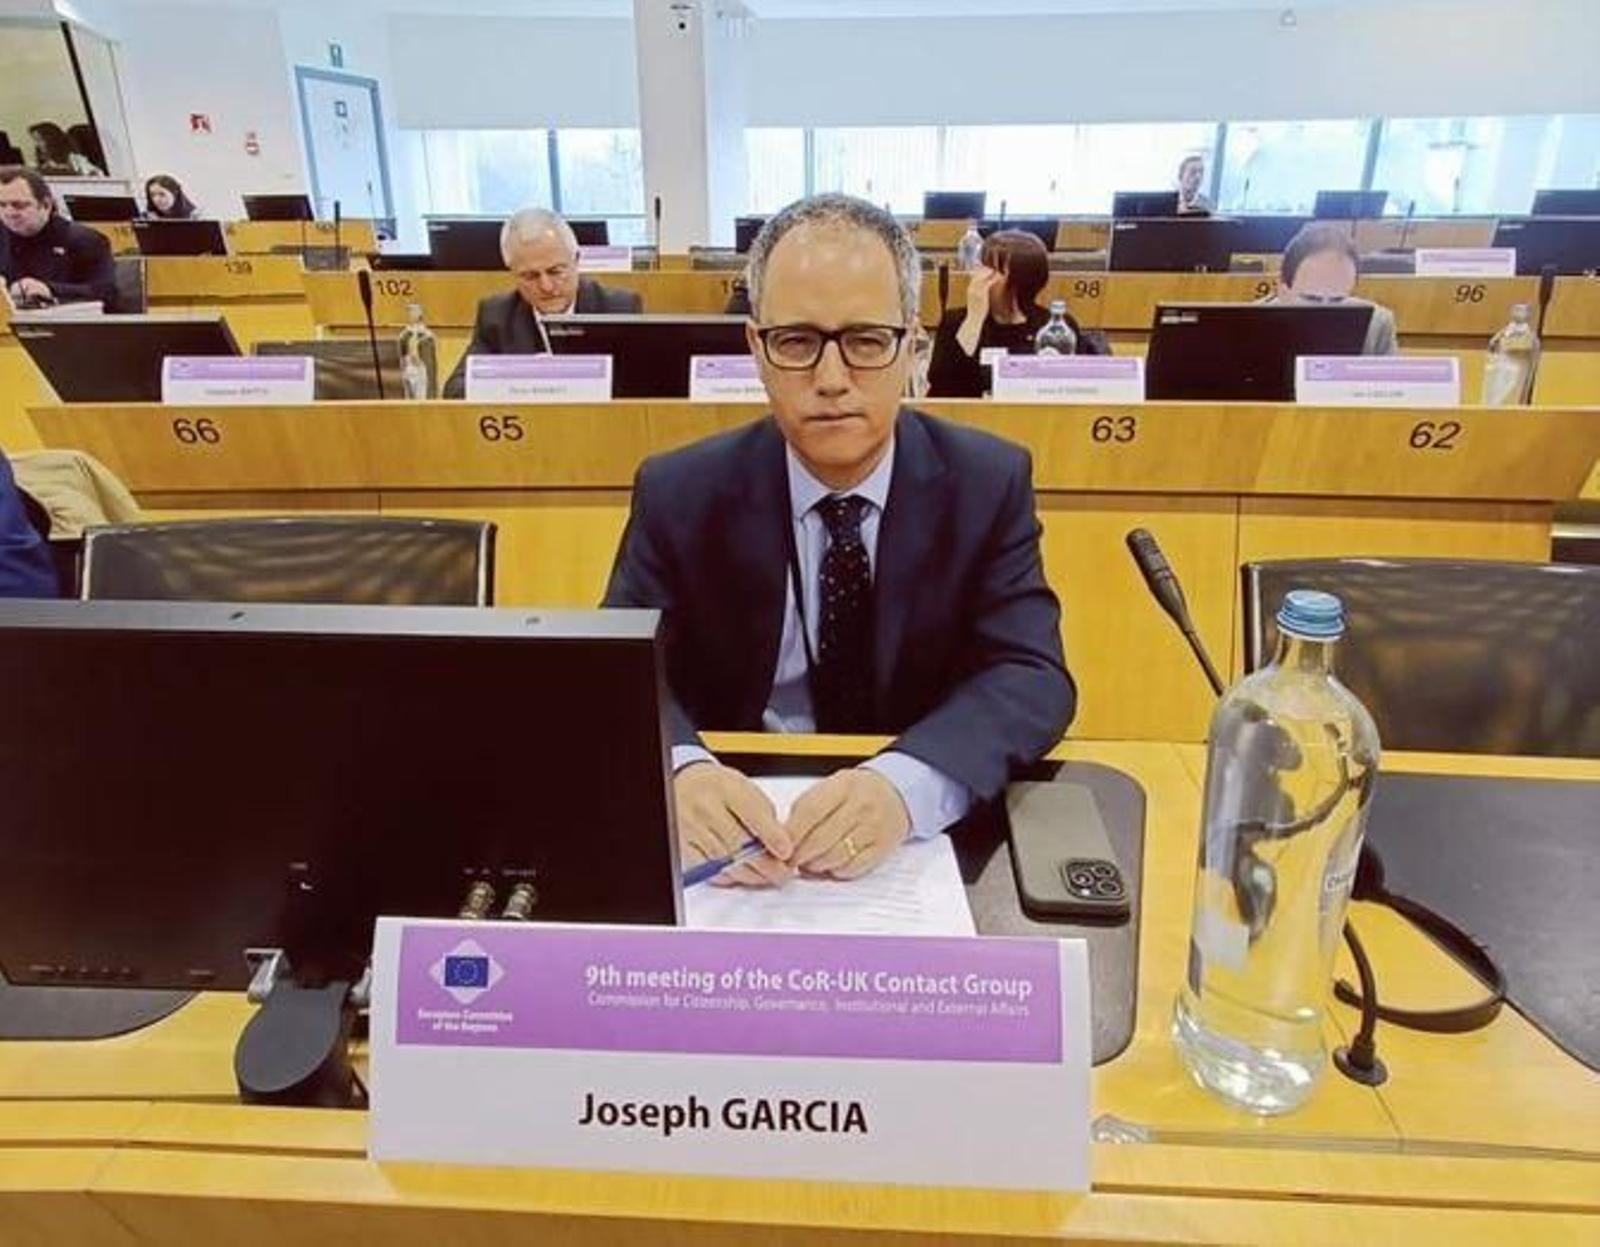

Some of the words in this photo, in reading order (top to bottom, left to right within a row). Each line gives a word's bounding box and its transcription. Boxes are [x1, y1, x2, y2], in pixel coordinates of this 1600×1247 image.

[377, 279, 415, 297] 102
[1073, 280, 1100, 299] 98
[1455, 284, 1487, 303] 96
[173, 418, 220, 444] 66
[480, 415, 524, 442] 65
[1091, 416, 1137, 443] 63
[1410, 420, 1462, 449] 62
[586, 965, 622, 987] 9th
[626, 966, 716, 993] meeting
[721, 967, 743, 989] of
[747, 967, 783, 990] the
[788, 969, 869, 992] CoR-UK
[874, 971, 958, 994] Contact
[964, 973, 1033, 1001] Group
[911, 999, 935, 1013] and
[578, 1093, 711, 1137] Joseph
[721, 1098, 868, 1133] GARCIA
